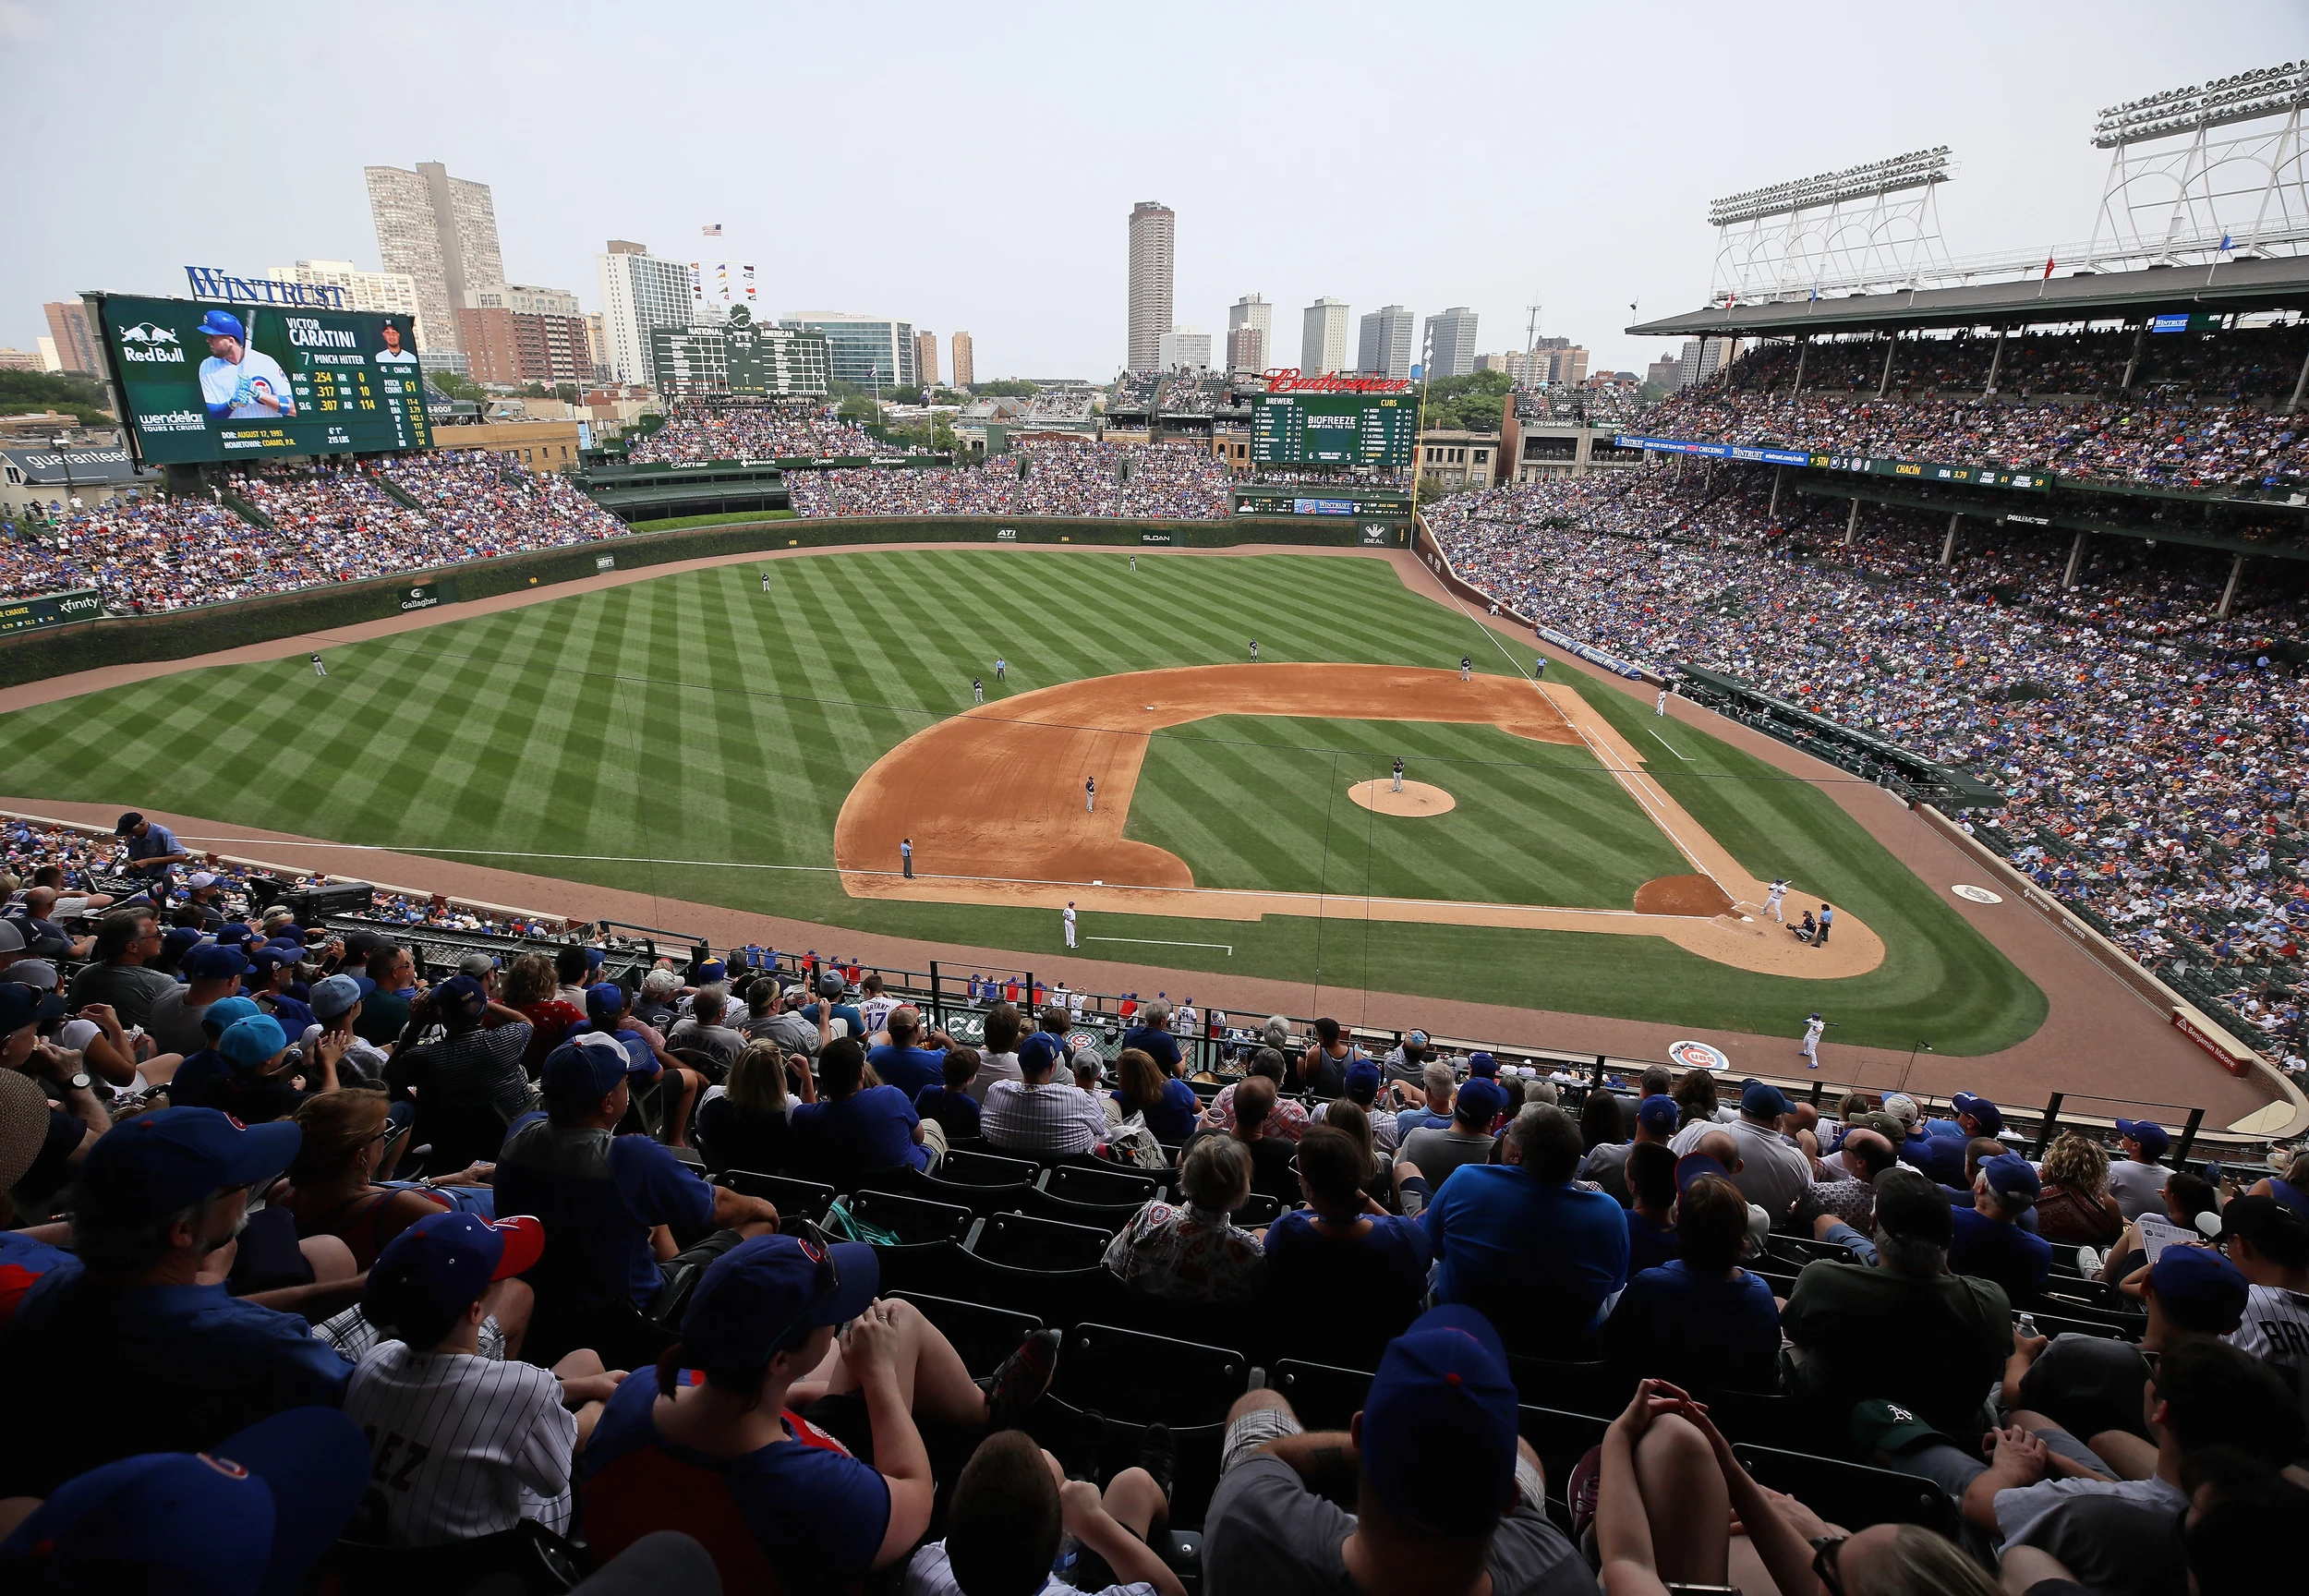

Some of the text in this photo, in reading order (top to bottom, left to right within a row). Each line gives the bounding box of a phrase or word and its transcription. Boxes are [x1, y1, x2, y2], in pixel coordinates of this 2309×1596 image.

[185, 265, 345, 308] WINTRUST
[285, 318, 320, 330] VICTOR
[687, 327, 724, 335] NATIONAL
[761, 330, 794, 338] AMERICAN
[289, 329, 357, 347] CARATINI
[124, 346, 185, 362] Red Bull
[301, 352, 365, 366] 7 PINCH HITTER
[292, 372, 365, 382] AVG .254 HR 0
[1263, 369, 1409, 392] Budweiser
[296, 386, 369, 396] OBP .317 RBI 10
[405, 381, 416, 392] 61
[298, 402, 312, 410] SLG
[320, 401, 337, 411] .307
[360, 400, 375, 410] 114
[139, 410, 198, 423] wendella
[237, 430, 259, 439] AUGUST
[1699, 446, 1725, 454] CHECKING!
[1732, 447, 1805, 463] WINTRUST wintrust.com/cubs
[1817, 456, 1870, 471] 5TH 5 0
[1896, 464, 1967, 478] CHACÍN ERA 3.79
[997, 529, 1016, 538] ATI
[59, 597, 98, 613] xfinity
[401, 597, 438, 610] Gallagher
[6, 607, 30, 616] CHAVEZ
[1539, 630, 1572, 649] Reynolds Wrap
[1580, 648, 1619, 671] Reynolds Wrap
[2062, 918, 2086, 938] nuveen
[866, 1001, 889, 1012] BRYANT
[868, 1012, 887, 1032] 17
[2188, 1027, 2235, 1068] Benjamin Moore
